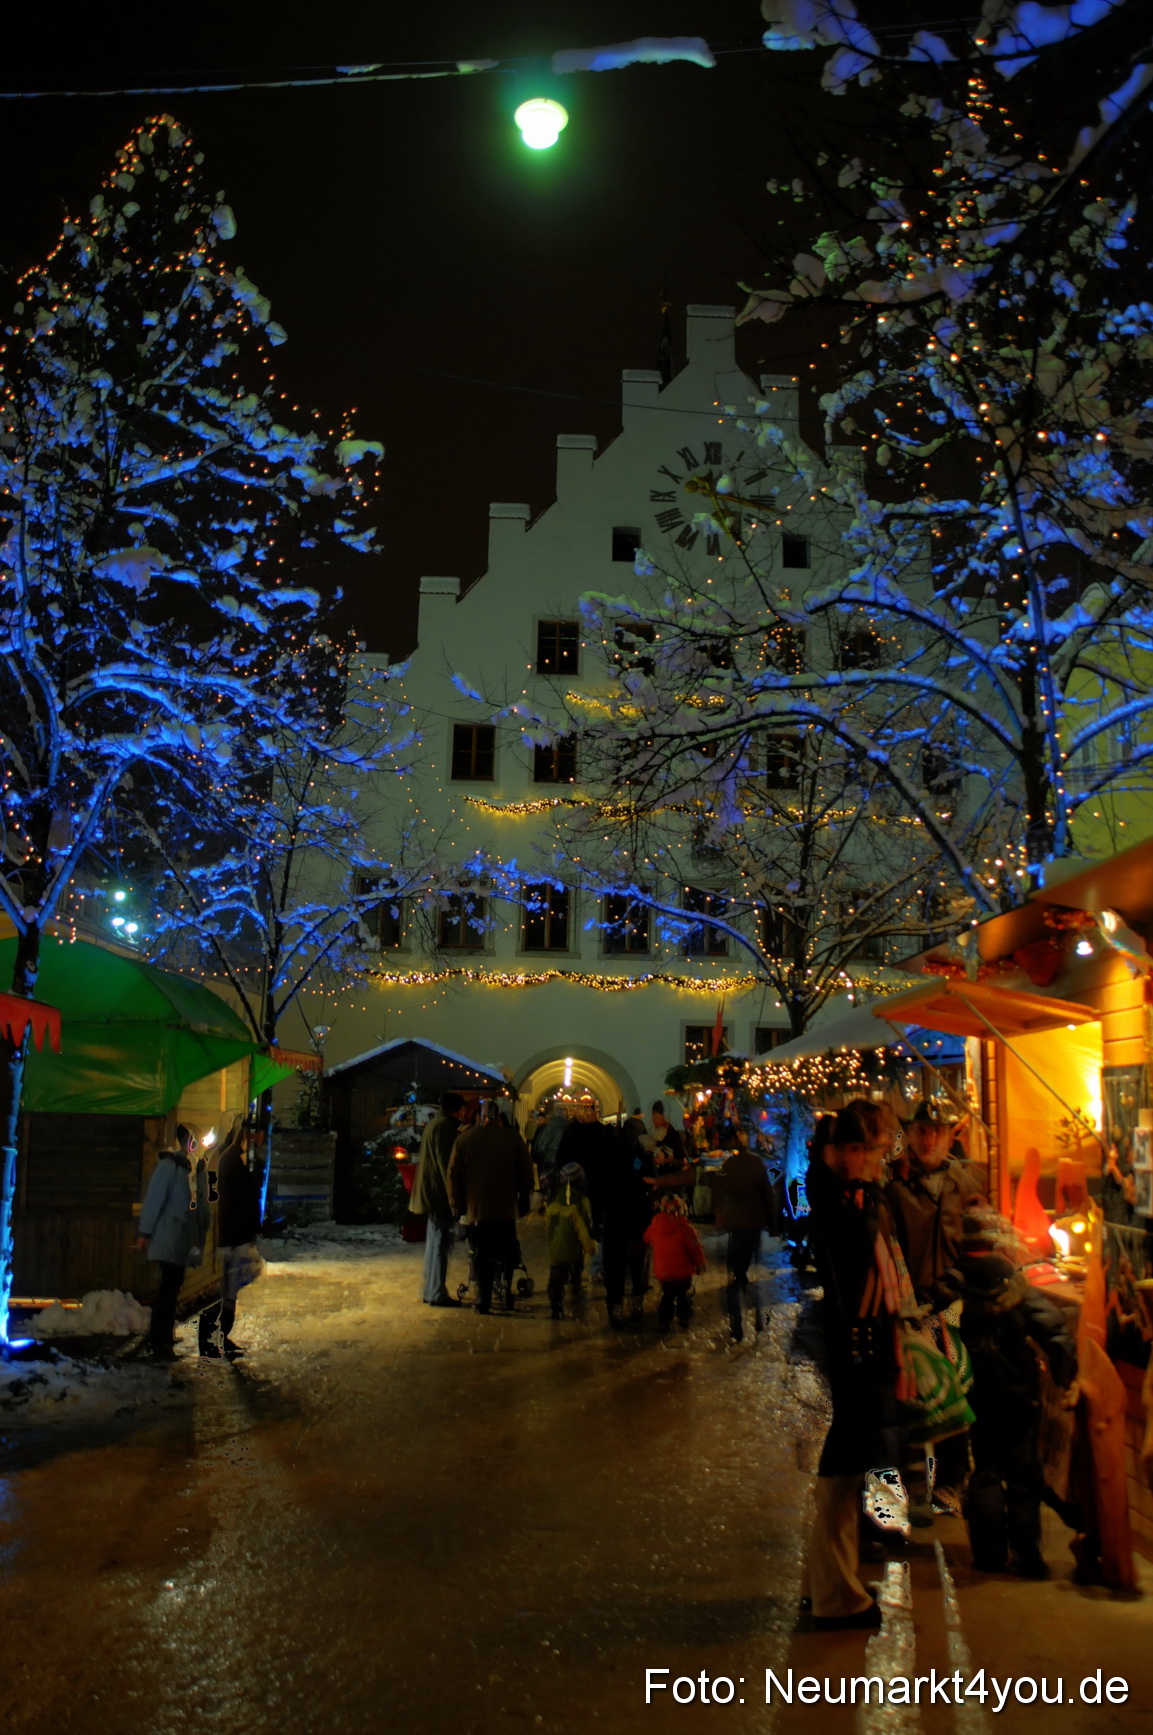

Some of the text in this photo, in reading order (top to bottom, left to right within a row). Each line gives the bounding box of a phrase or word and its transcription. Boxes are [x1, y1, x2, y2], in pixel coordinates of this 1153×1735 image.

[676, 446, 700, 471] XI
[703, 441, 722, 465] XII
[657, 465, 684, 484] X
[743, 470, 769, 486] II
[650, 489, 677, 502] IX
[654, 507, 685, 534] VIII
